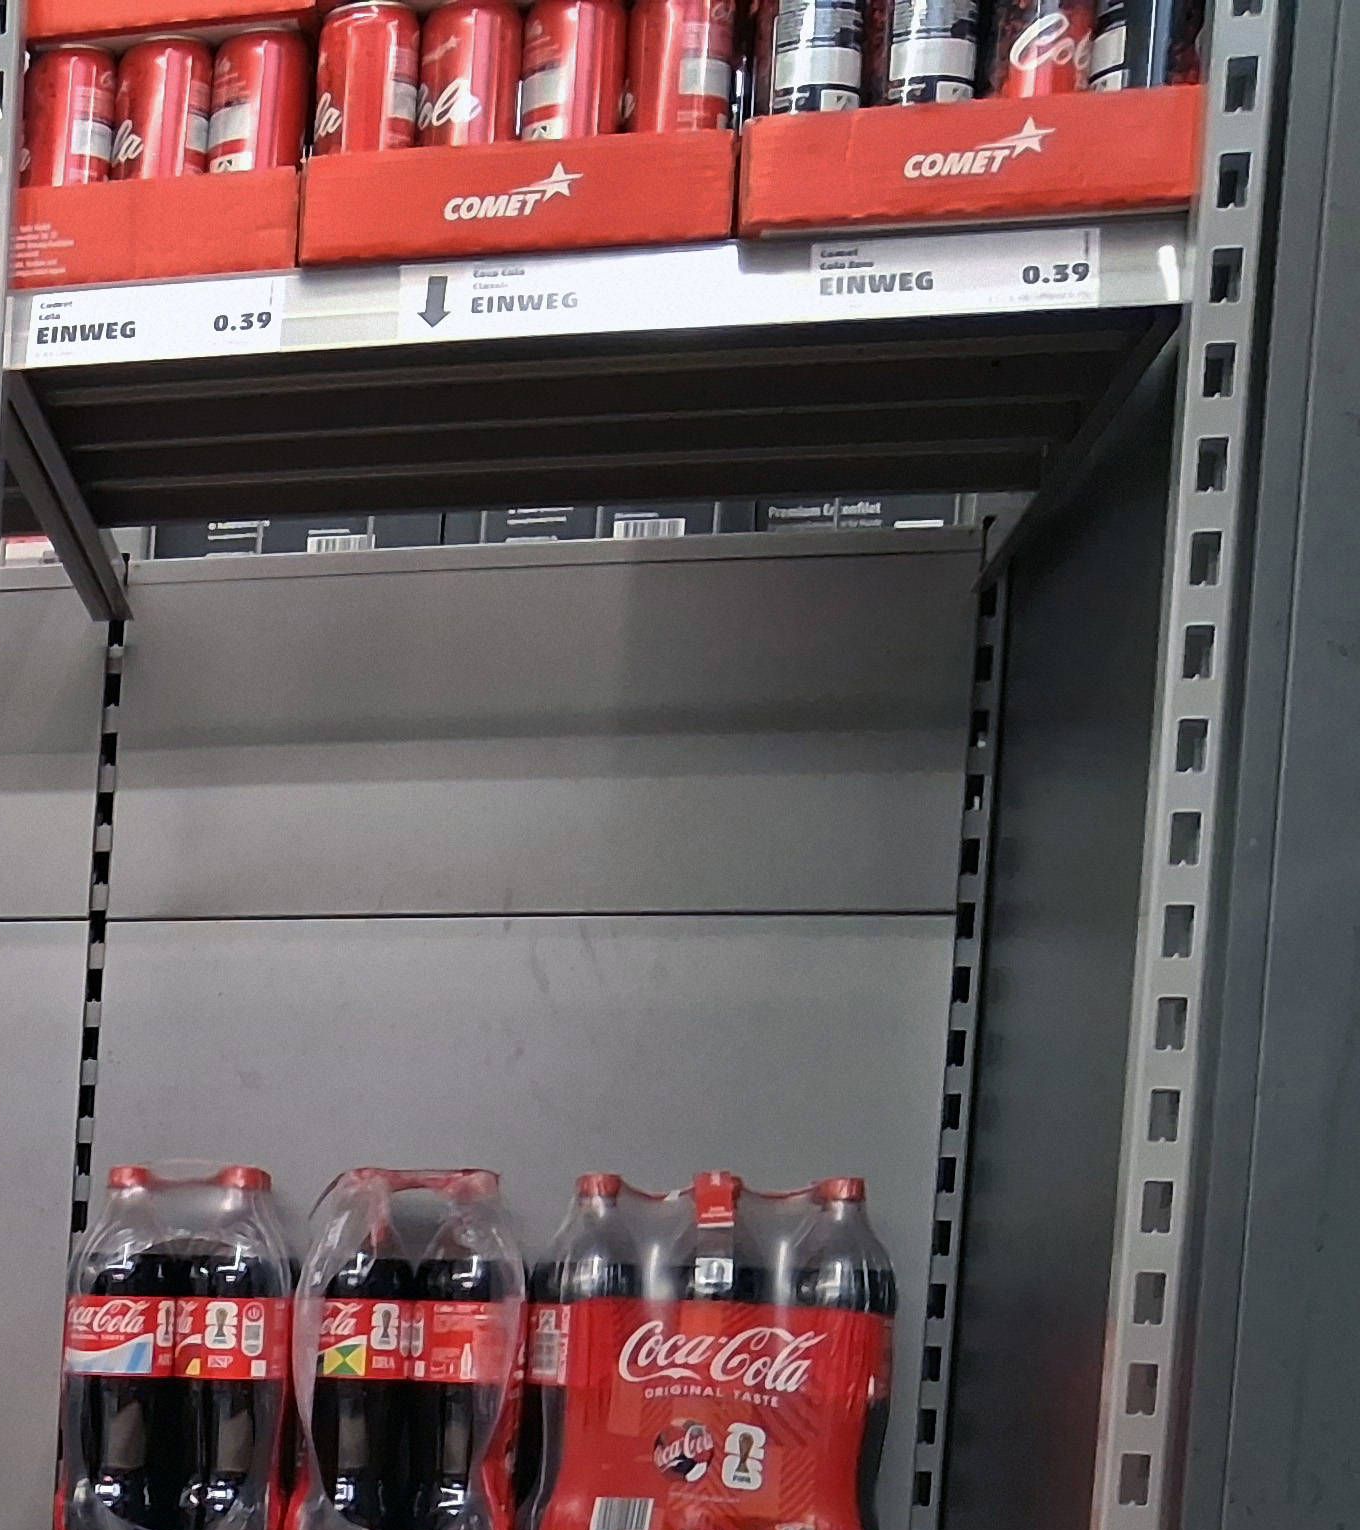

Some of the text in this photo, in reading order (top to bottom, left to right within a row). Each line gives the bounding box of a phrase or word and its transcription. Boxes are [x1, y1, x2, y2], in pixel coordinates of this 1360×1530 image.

[904, 150, 1010, 178] COMET
[444, 193, 542, 221] COMET
[820, 262, 1091, 296] EINWEG 0.39
[471, 291, 578, 314] EINWEG
[37, 311, 272, 345] EINWEG 0.39
[618, 1320, 827, 1394] Coca-Cola
[644, 1385, 779, 1408] ORIGINAL TASTE
